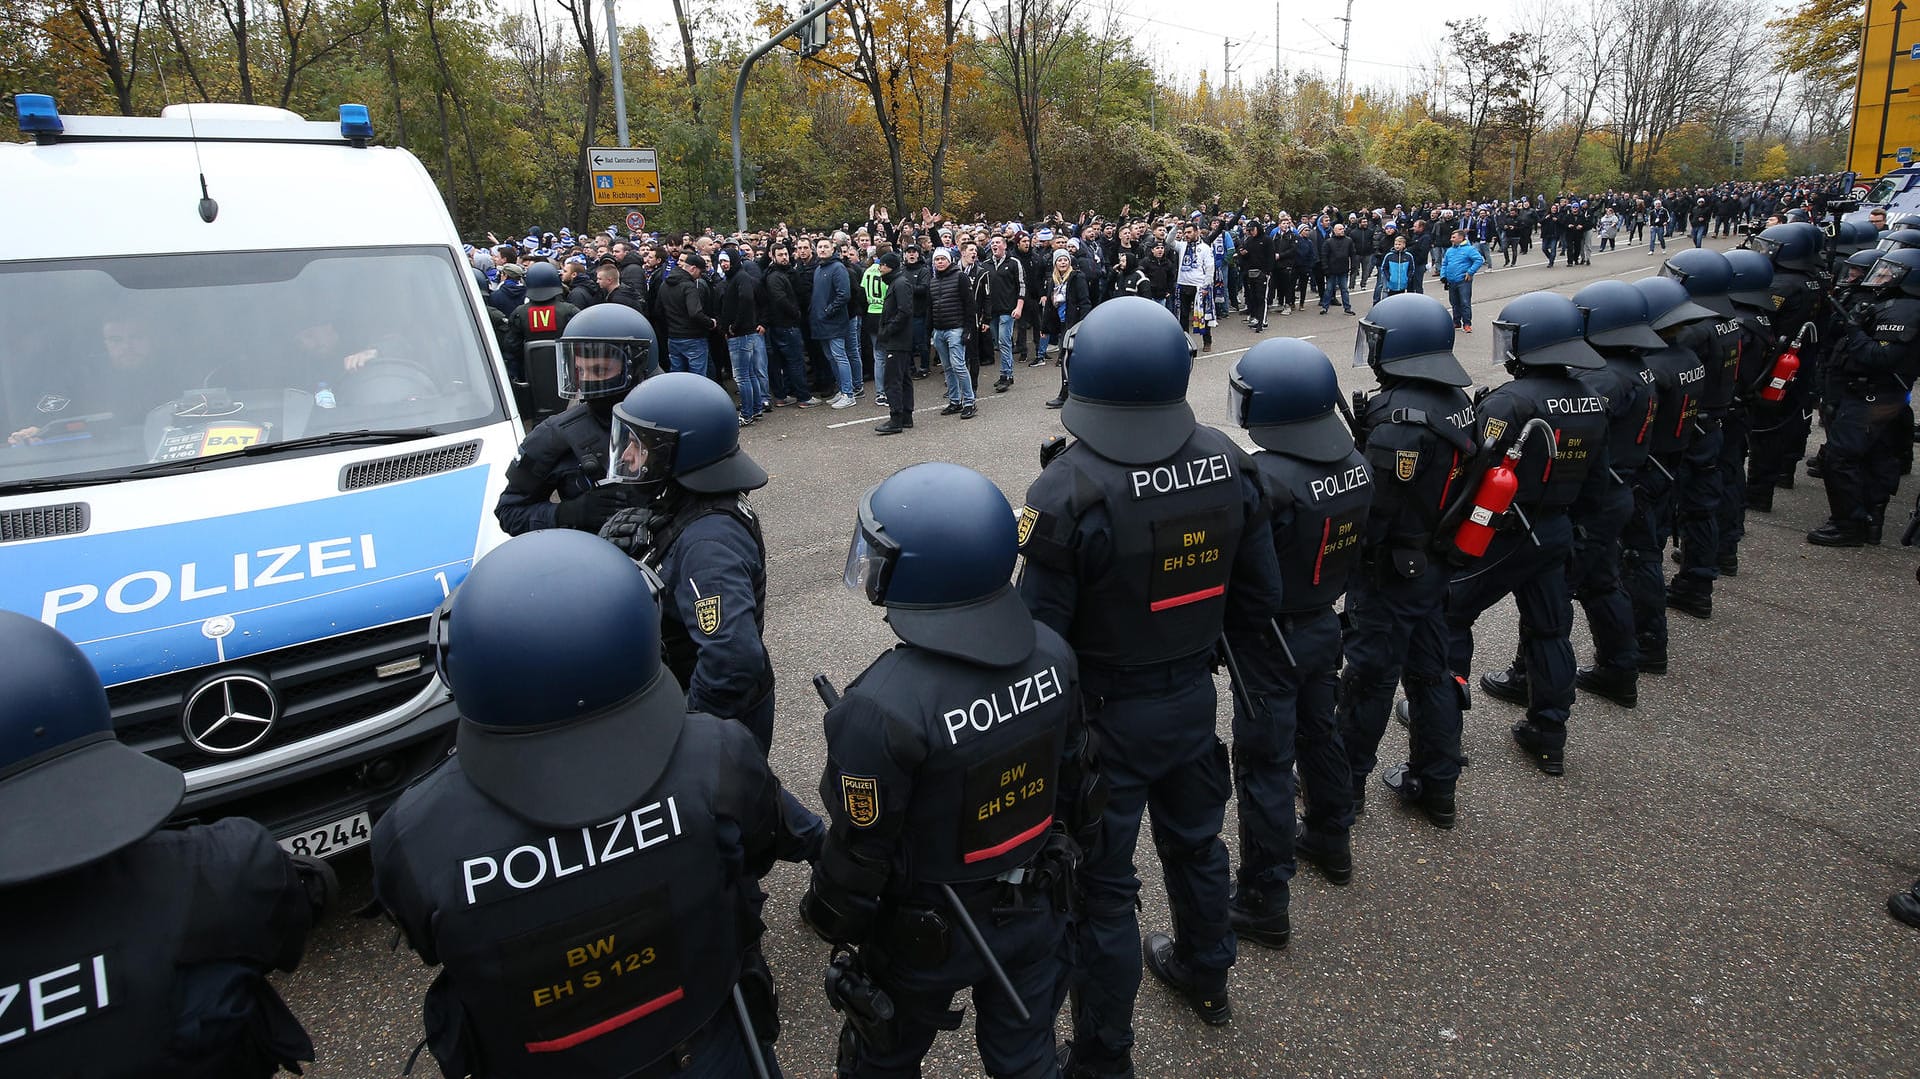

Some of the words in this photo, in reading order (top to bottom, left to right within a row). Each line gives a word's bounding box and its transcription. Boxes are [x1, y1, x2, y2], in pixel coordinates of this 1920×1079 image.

[598, 191, 611, 199] Alle
[612, 191, 646, 200] Richtungen
[866, 275, 882, 298] 10
[533, 309, 551, 328] IV
[1876, 324, 1905, 332] POLIZEI
[1546, 396, 1603, 414] POLIZEI
[168, 443, 194, 453] BFE
[207, 435, 254, 446] BAT
[1567, 438, 1582, 447] BW
[1131, 454, 1232, 498] POLIZEI
[1310, 464, 1370, 502] POLIZEI
[1183, 530, 1206, 548] BW
[1339, 522, 1353, 536] BW
[1164, 553, 1183, 572] EH
[1186, 552, 1196, 567] S
[1199, 548, 1219, 565] 123
[41, 533, 377, 629] POLIZEI
[434, 571, 450, 598] 1
[943, 666, 1063, 745] POLIZEI
[845, 779, 873, 790] POLIZEI
[1001, 762, 1027, 788] BW
[979, 797, 1001, 820] EH
[1005, 791, 1016, 808] S
[1020, 777, 1044, 800] 123
[292, 817, 369, 857] 8244
[462, 796, 685, 905] POLIZEI
[566, 934, 616, 968] BW
[532, 980, 575, 1008] EH
[582, 970, 603, 989] S
[610, 947, 656, 977] 123
